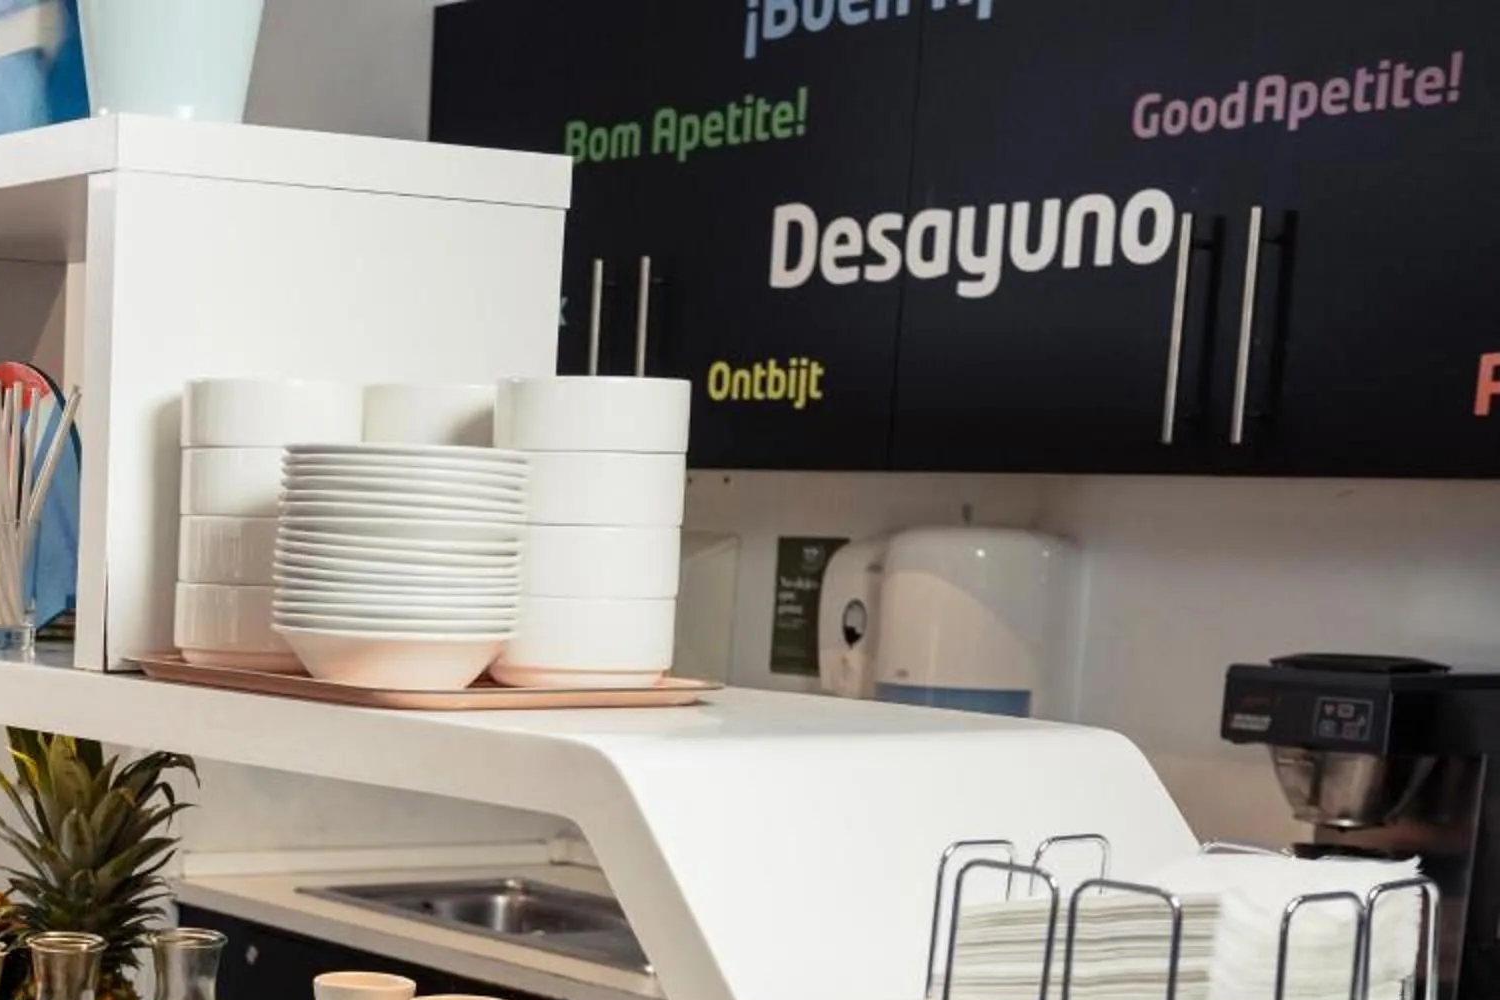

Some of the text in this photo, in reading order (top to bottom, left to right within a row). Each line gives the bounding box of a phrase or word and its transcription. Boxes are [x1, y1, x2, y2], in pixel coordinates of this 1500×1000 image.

[565, 86, 808, 164] Bom Apetite!
[1133, 51, 1464, 139] Good Apetite!
[769, 188, 1176, 298] Desayuno
[707, 357, 824, 409] Ontbijt
